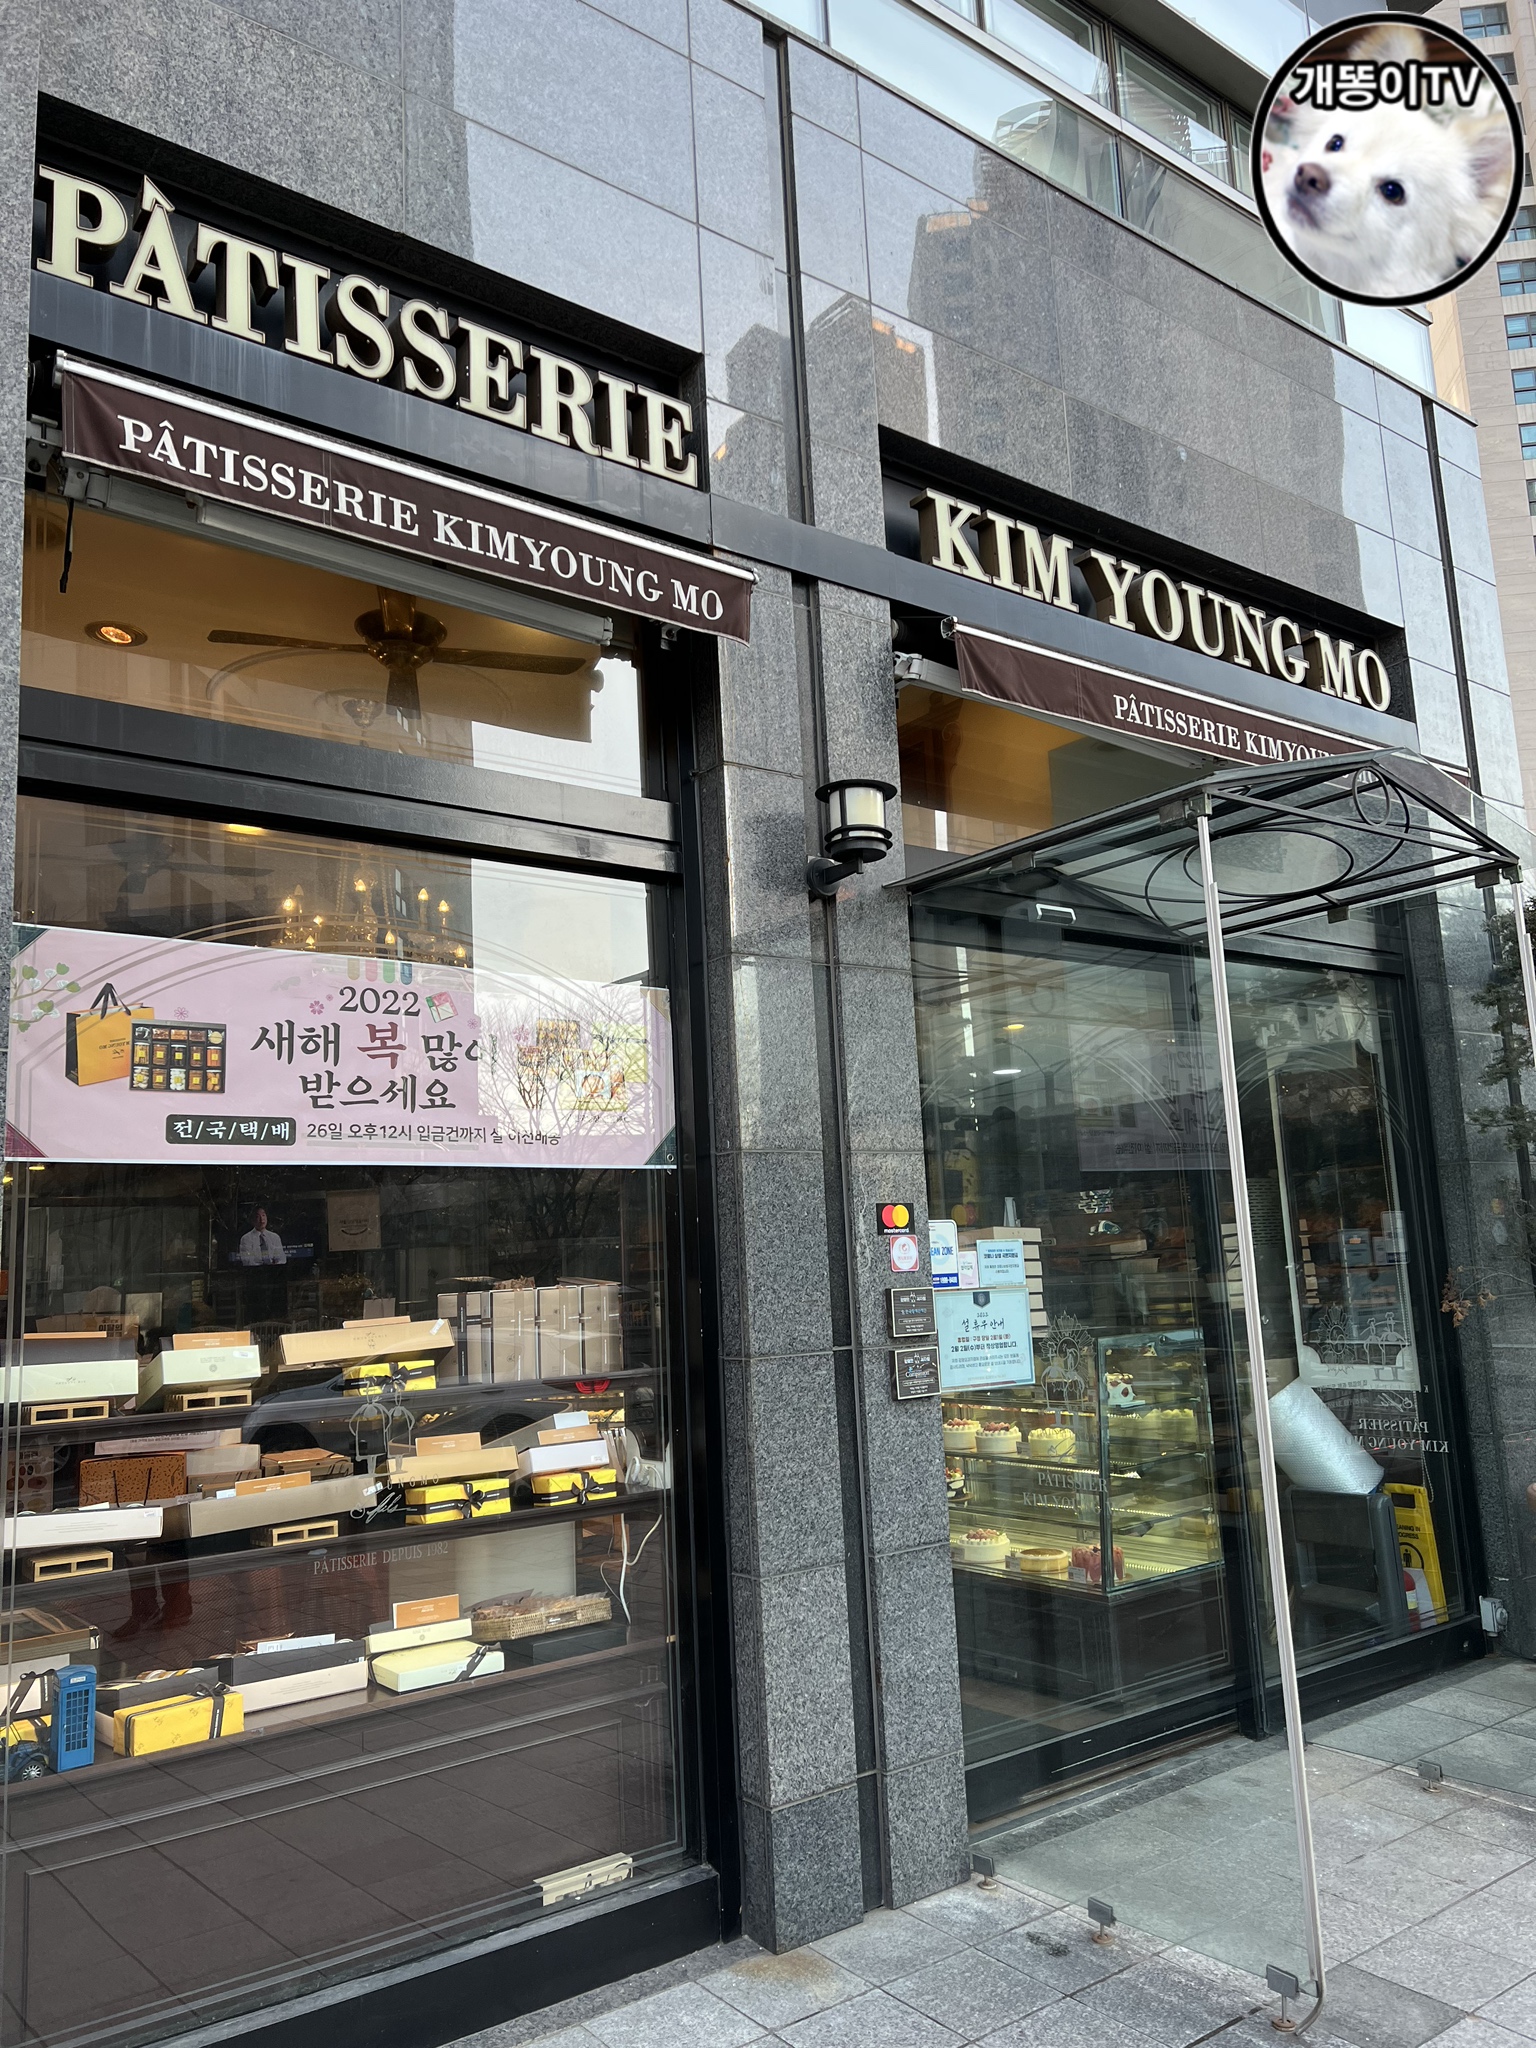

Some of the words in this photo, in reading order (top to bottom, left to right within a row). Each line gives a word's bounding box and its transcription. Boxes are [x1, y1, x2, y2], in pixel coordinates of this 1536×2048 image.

[36, 164, 698, 488] PÂTISSERIE
[117, 414, 419, 537] PÂTISSERIE
[432, 510, 664, 602] KIMYOUNG
[671, 579, 724, 621] MO
[922, 487, 1080, 613] KIM
[1083, 547, 1310, 685] YOUNG
[1313, 629, 1392, 712] MO
[1112, 693, 1241, 750] PÂTISSERIE
[339, 986, 421, 1017] 2022
[250, 1019, 341, 1067] 새해
[356, 1021, 407, 1070] 복
[298, 1069, 457, 1114] 받으세요
[173, 1119, 290, 1141] 전/국/택/배
[307, 1122, 343, 1140] 26일
[348, 1123, 412, 1141] 오후12시
[416, 1124, 487, 1144] 입금건까지
[382, 1545, 422, 1564] DEPUIS
[427, 1541, 449, 1557] 1982
